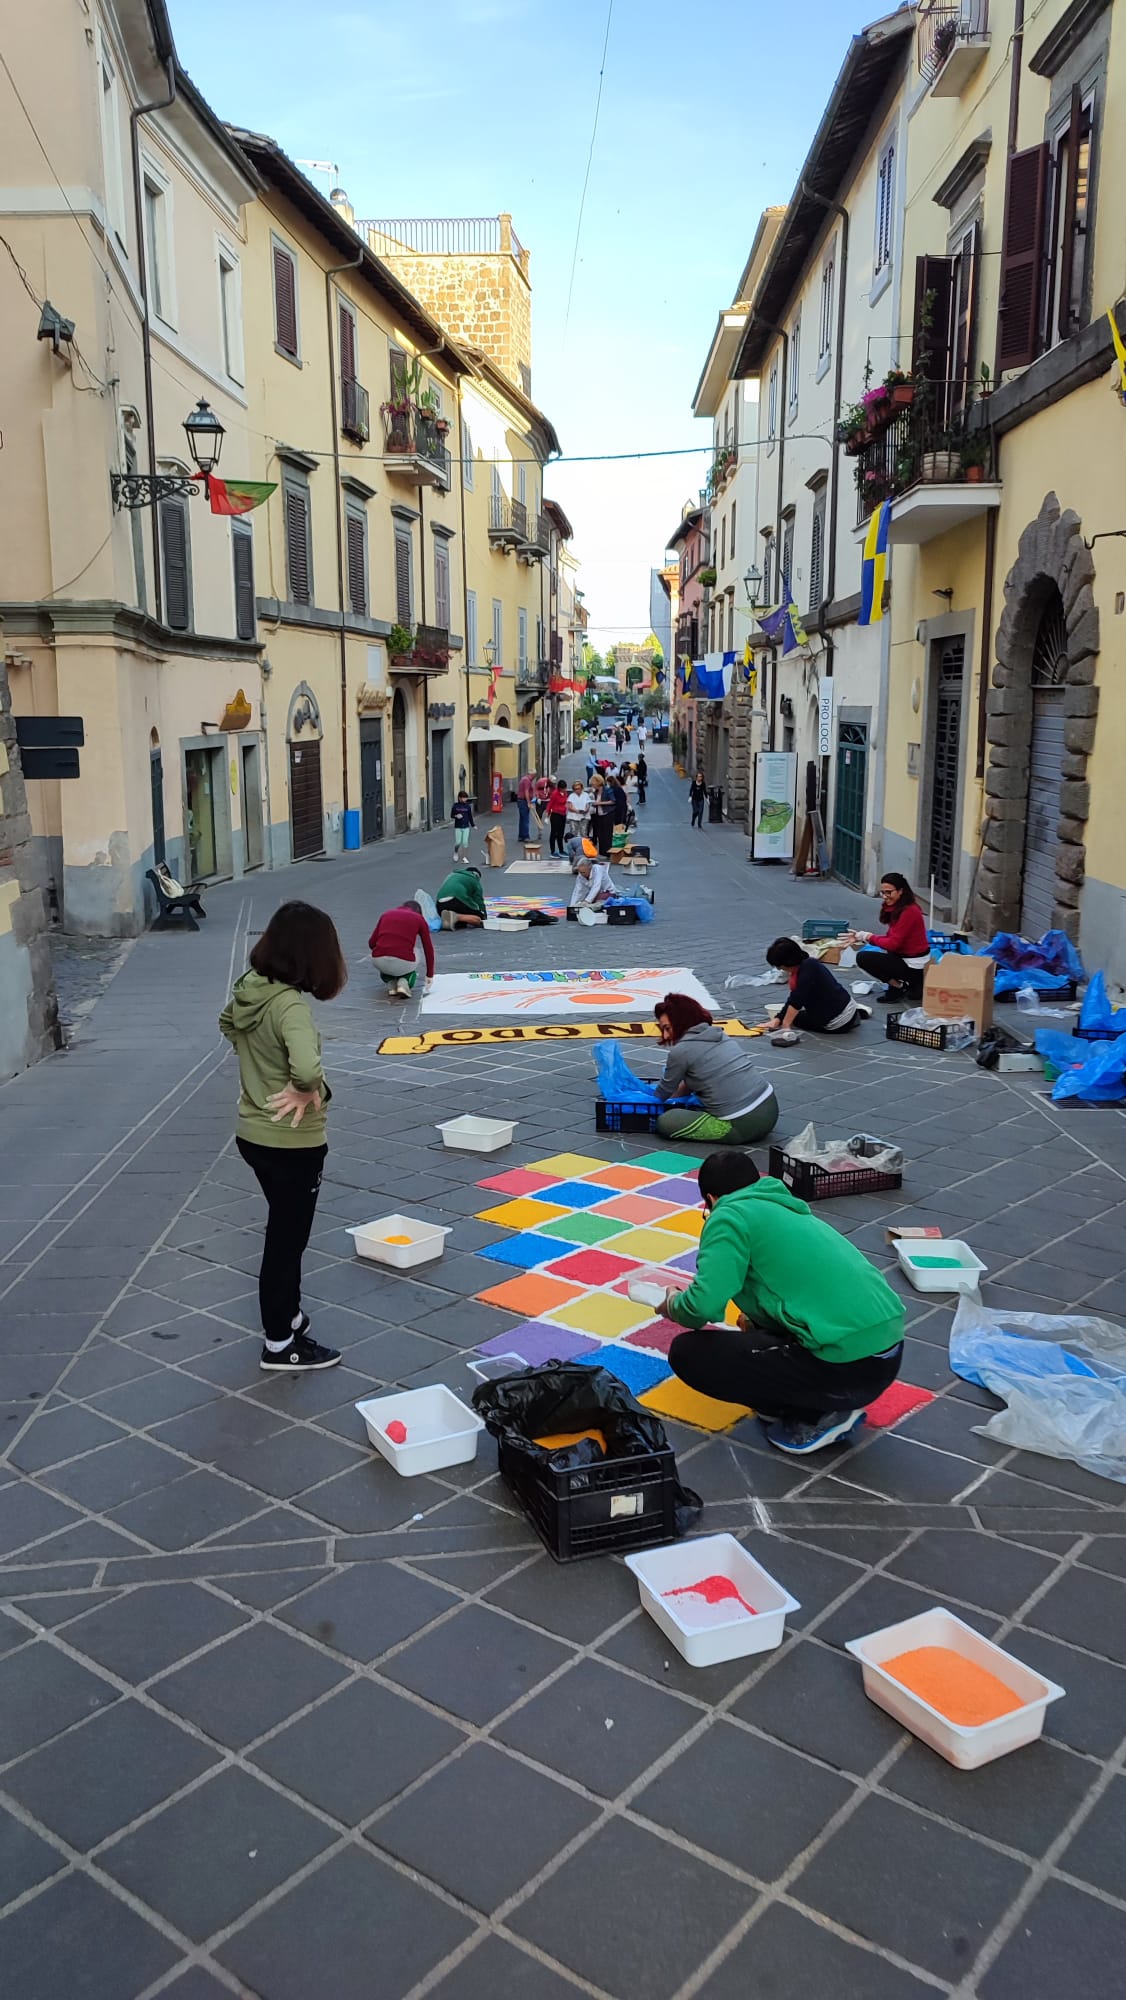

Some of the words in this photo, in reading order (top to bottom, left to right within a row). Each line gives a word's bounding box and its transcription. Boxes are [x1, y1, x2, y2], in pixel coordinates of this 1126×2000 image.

[821, 698, 830, 720] PRO
[820, 723, 829, 753] LOCO
[442, 1021, 727, 1042] NODO
